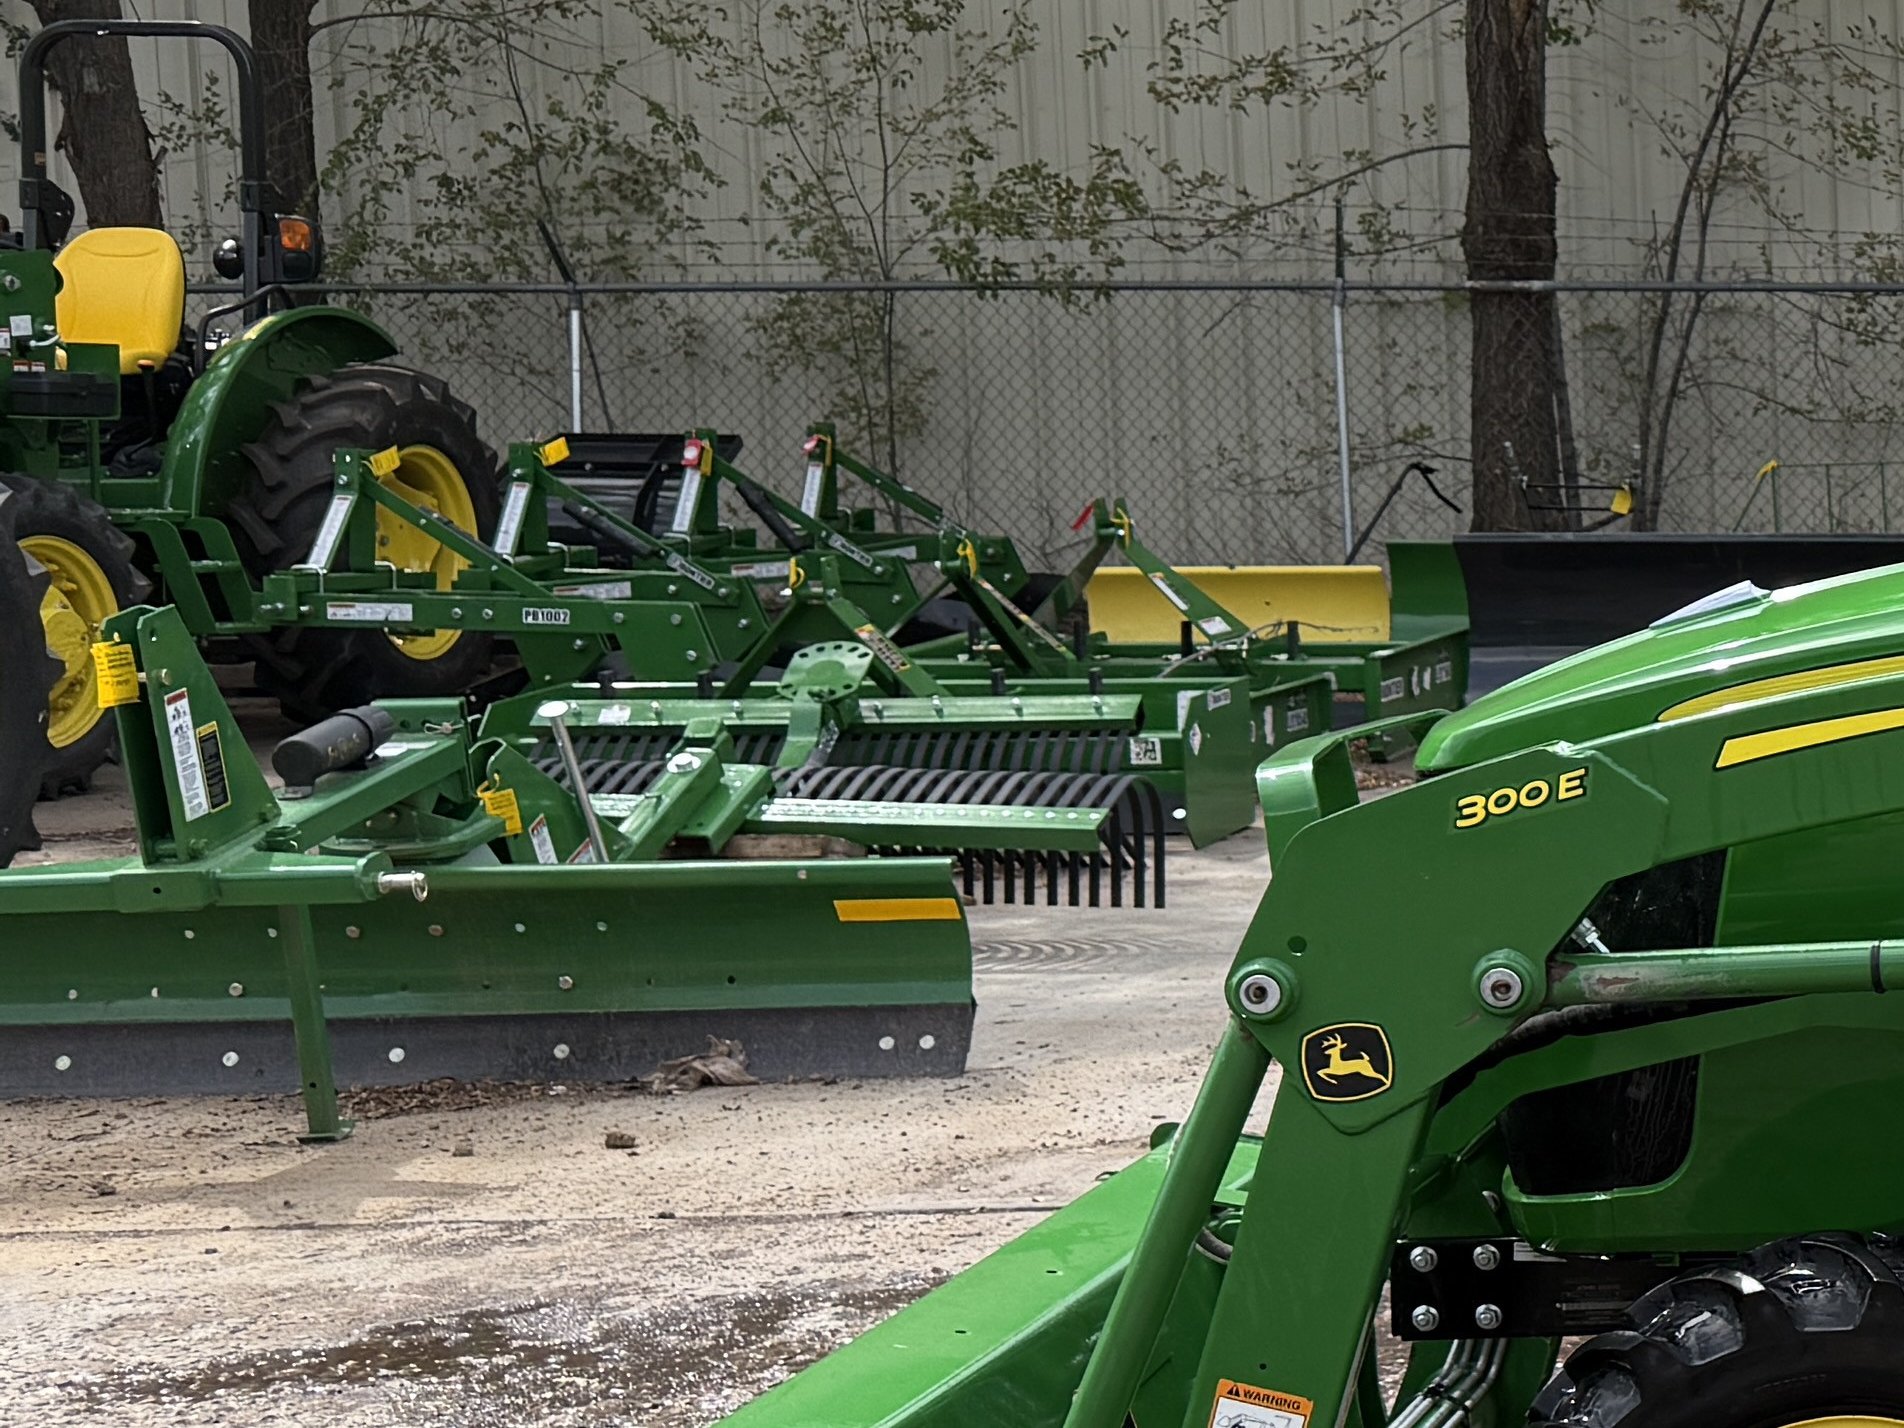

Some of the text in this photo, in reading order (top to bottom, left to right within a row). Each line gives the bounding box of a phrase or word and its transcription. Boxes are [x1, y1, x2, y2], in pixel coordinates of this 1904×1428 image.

[523, 609, 570, 623] PB1002
[1455, 767, 1587, 829] 300 E
[1242, 1387, 1302, 1412] WARNING
